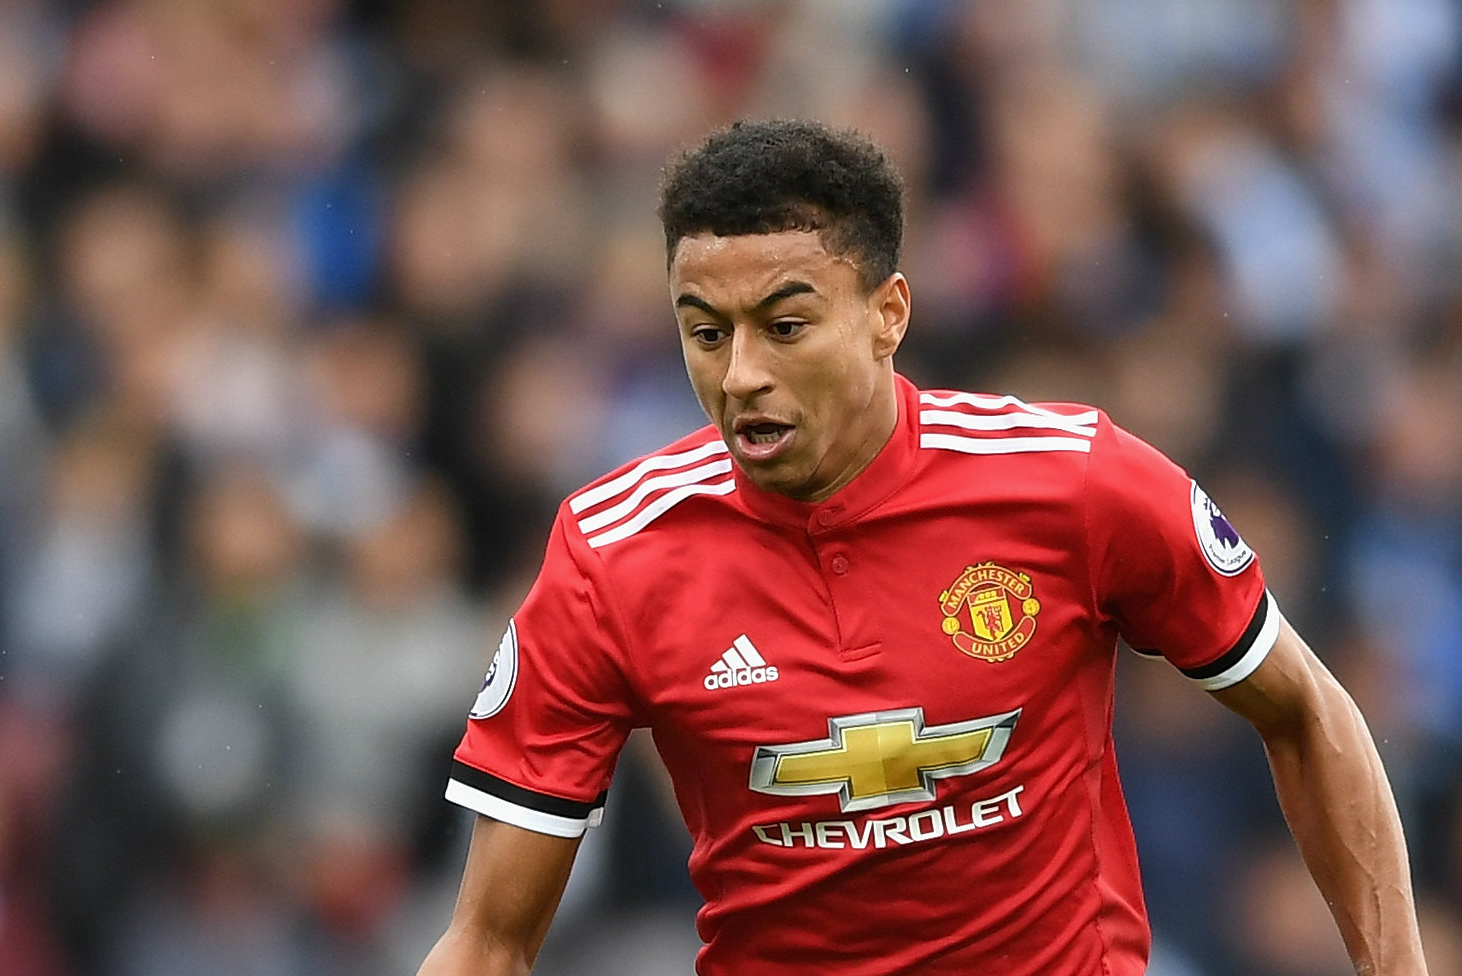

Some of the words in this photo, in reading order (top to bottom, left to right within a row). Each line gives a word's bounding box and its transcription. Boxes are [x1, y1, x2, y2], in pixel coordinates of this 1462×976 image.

[948, 569, 1026, 610] MANCHESTER
[971, 631, 1026, 656] UNITED
[703, 665, 780, 691] adidas
[751, 784, 1025, 850] CHEVROLET
